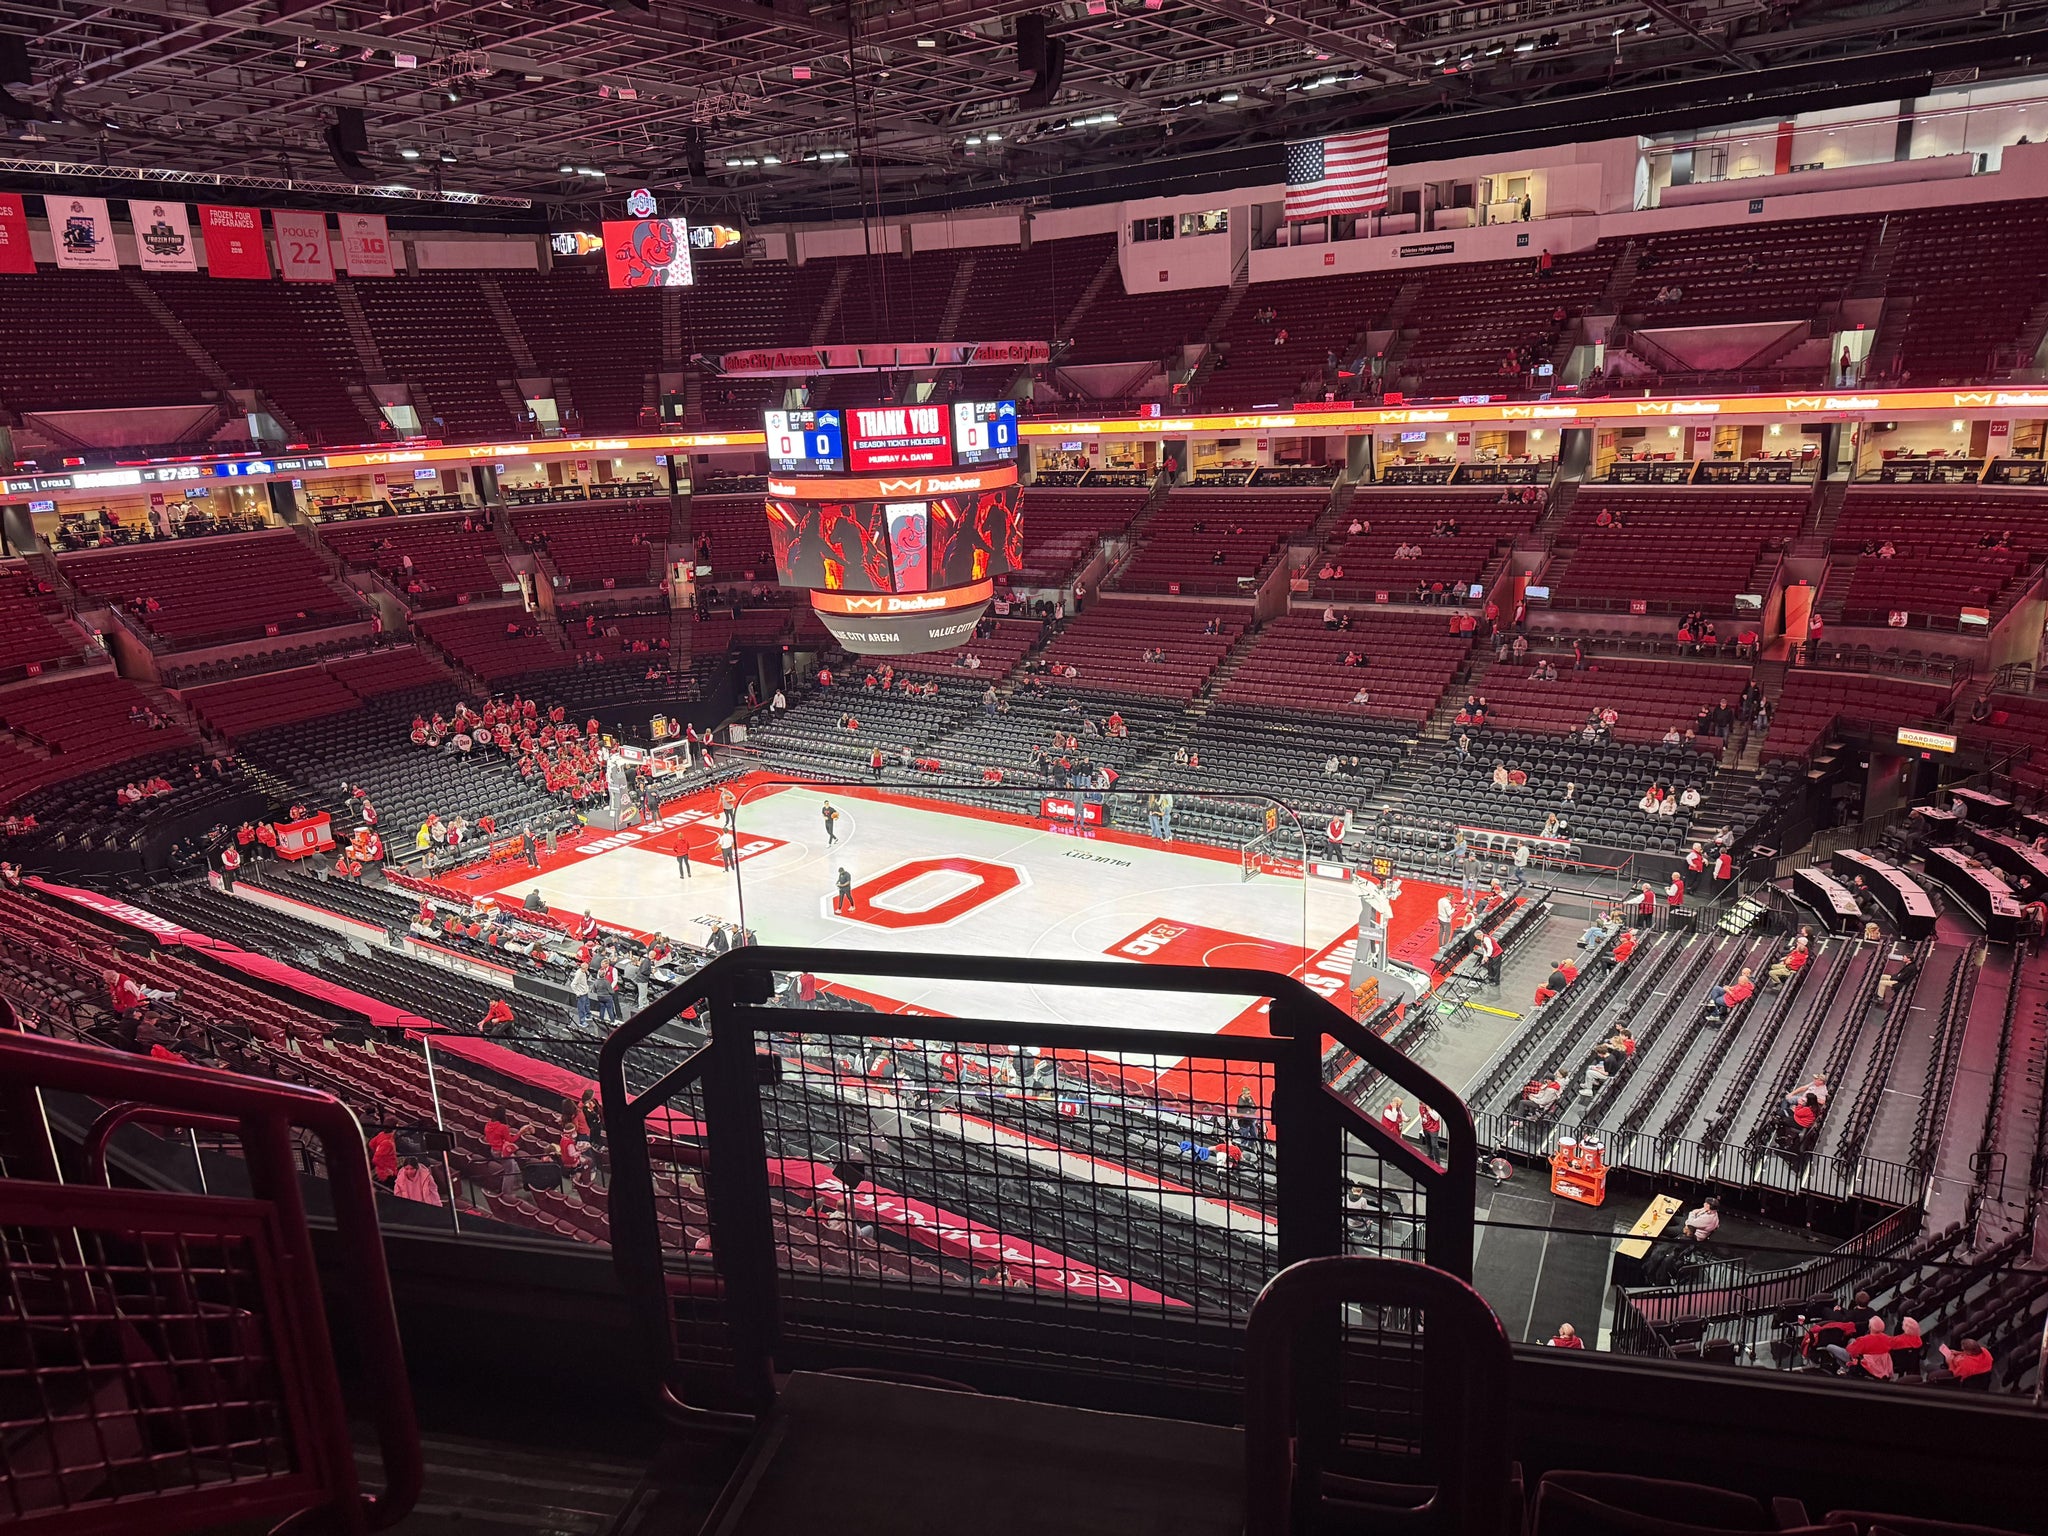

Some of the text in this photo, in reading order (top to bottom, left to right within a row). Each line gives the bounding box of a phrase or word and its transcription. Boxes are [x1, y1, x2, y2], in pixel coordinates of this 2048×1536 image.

[210, 210, 250, 220] FROZEN FOUR
[210, 219, 254, 228] APPEARANCES
[282, 228, 319, 238] POOLEY
[290, 242, 320, 264] 22
[749, 354, 775, 370] City
[774, 353, 820, 368] Arena
[789, 412, 814, 422] 27:22
[857, 410, 907, 437] THANK
[909, 408, 939, 434] YOU
[968, 429, 976, 446] 0
[997, 424, 1007, 444] 0
[781, 436, 791, 454] 0
[817, 435, 829, 454] 0
[911, 438, 940, 446] HOLDERS
[869, 455, 900, 463] MURRAY
[159, 467, 200, 481] 27:22
[228, 464, 238, 476] 0
[48, 479, 70, 487] FOULS
[927, 477, 980, 492] Duchess
[888, 597, 946, 611] Duchess
[846, 632, 866, 642] CITY
[868, 633, 900, 642] ARENA
[929, 626, 956, 638] VALUE
[956, 622, 973, 634] CITY
[654, 726, 665, 735] 30
[1904, 734, 1952, 746] BOARDROOM
[1266, 816, 1276, 832] 30
[302, 826, 318, 847] O
[575, 832, 642, 854] OHIO
[1062, 851, 1131, 867] VALUE CITY
[824, 854, 1030, 932] O
